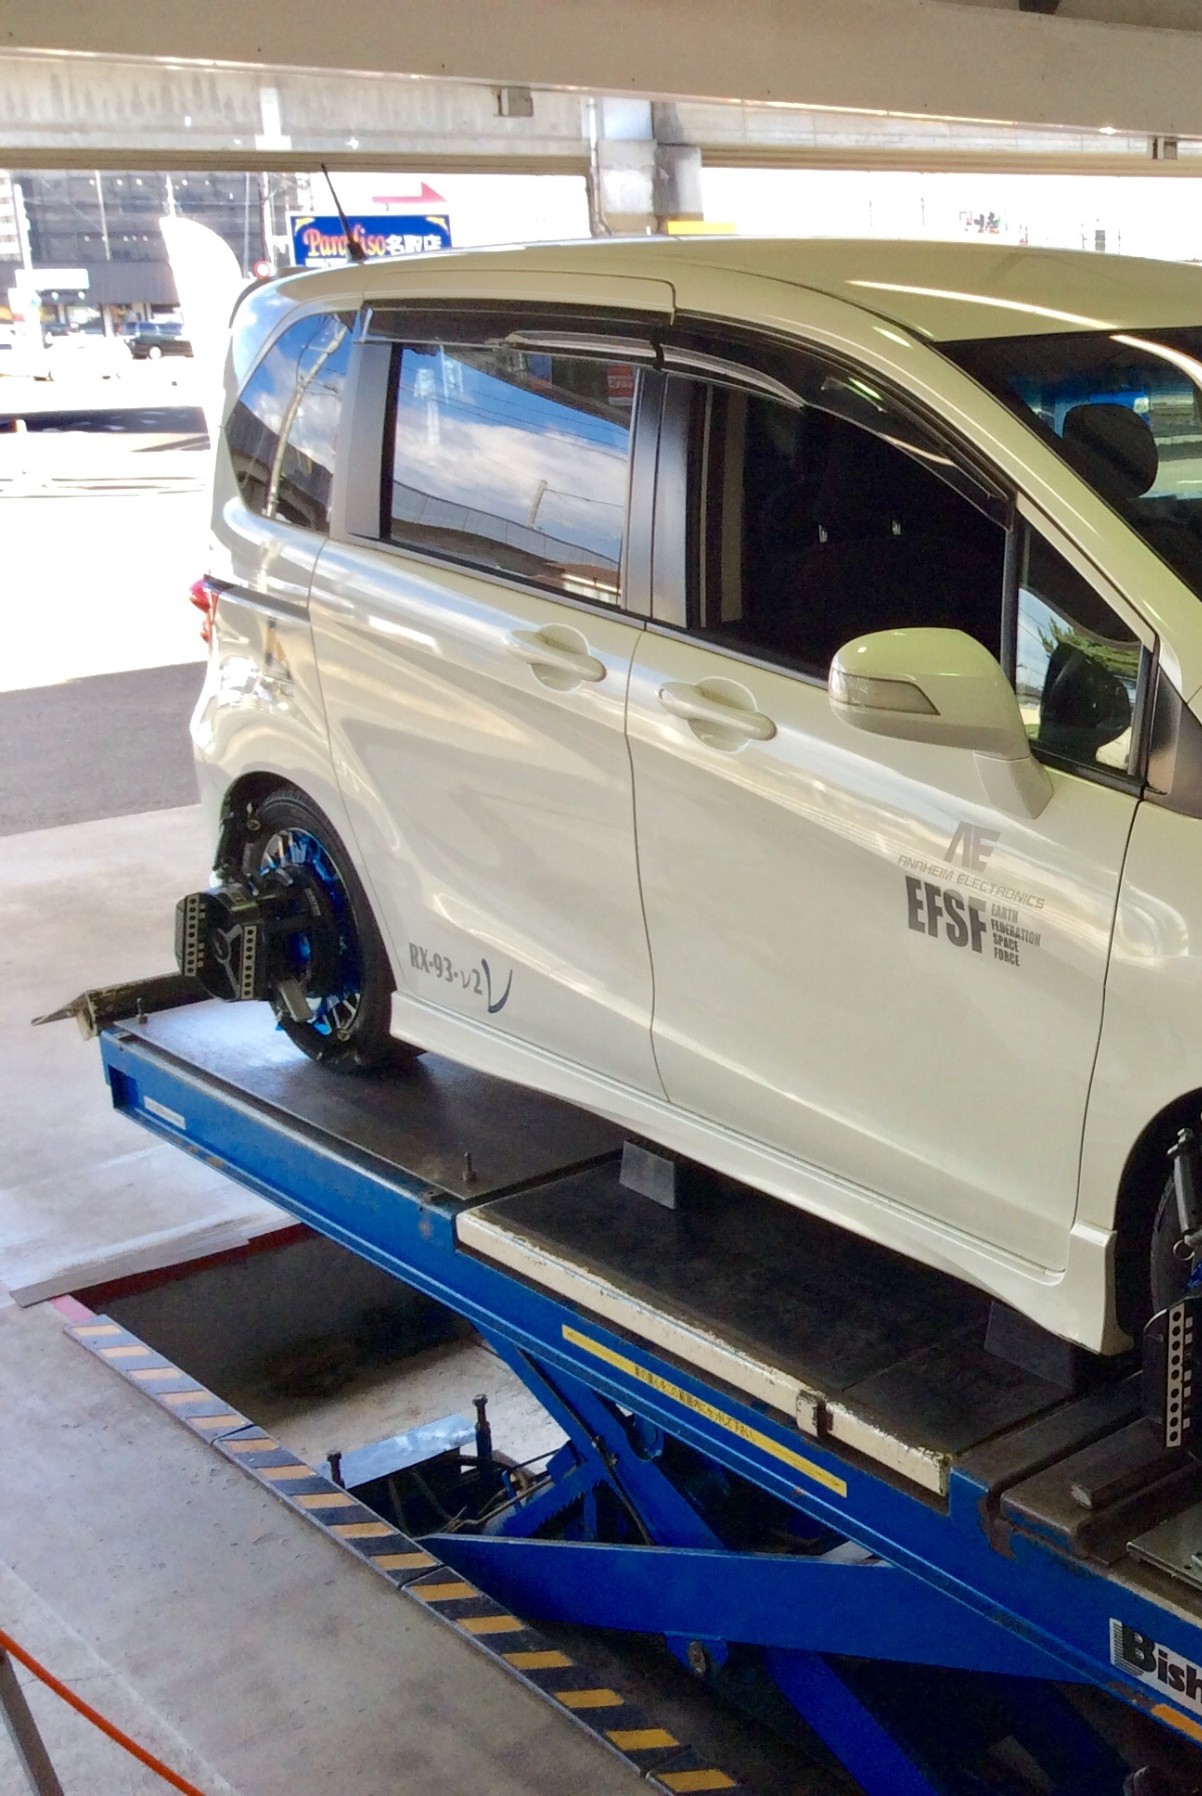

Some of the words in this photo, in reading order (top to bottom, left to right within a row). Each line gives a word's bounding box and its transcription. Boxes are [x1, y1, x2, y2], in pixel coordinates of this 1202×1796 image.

[897, 854, 954, 882] ANAHEIM
[956, 873, 1046, 910] ELECTRONICS
[904, 875, 987, 954] EFSF
[991, 903, 1019, 924] EARTH
[991, 918, 1041, 947] FEDERATION
[992, 932, 1019, 953] SPACE
[993, 945, 1020, 967] FORCE
